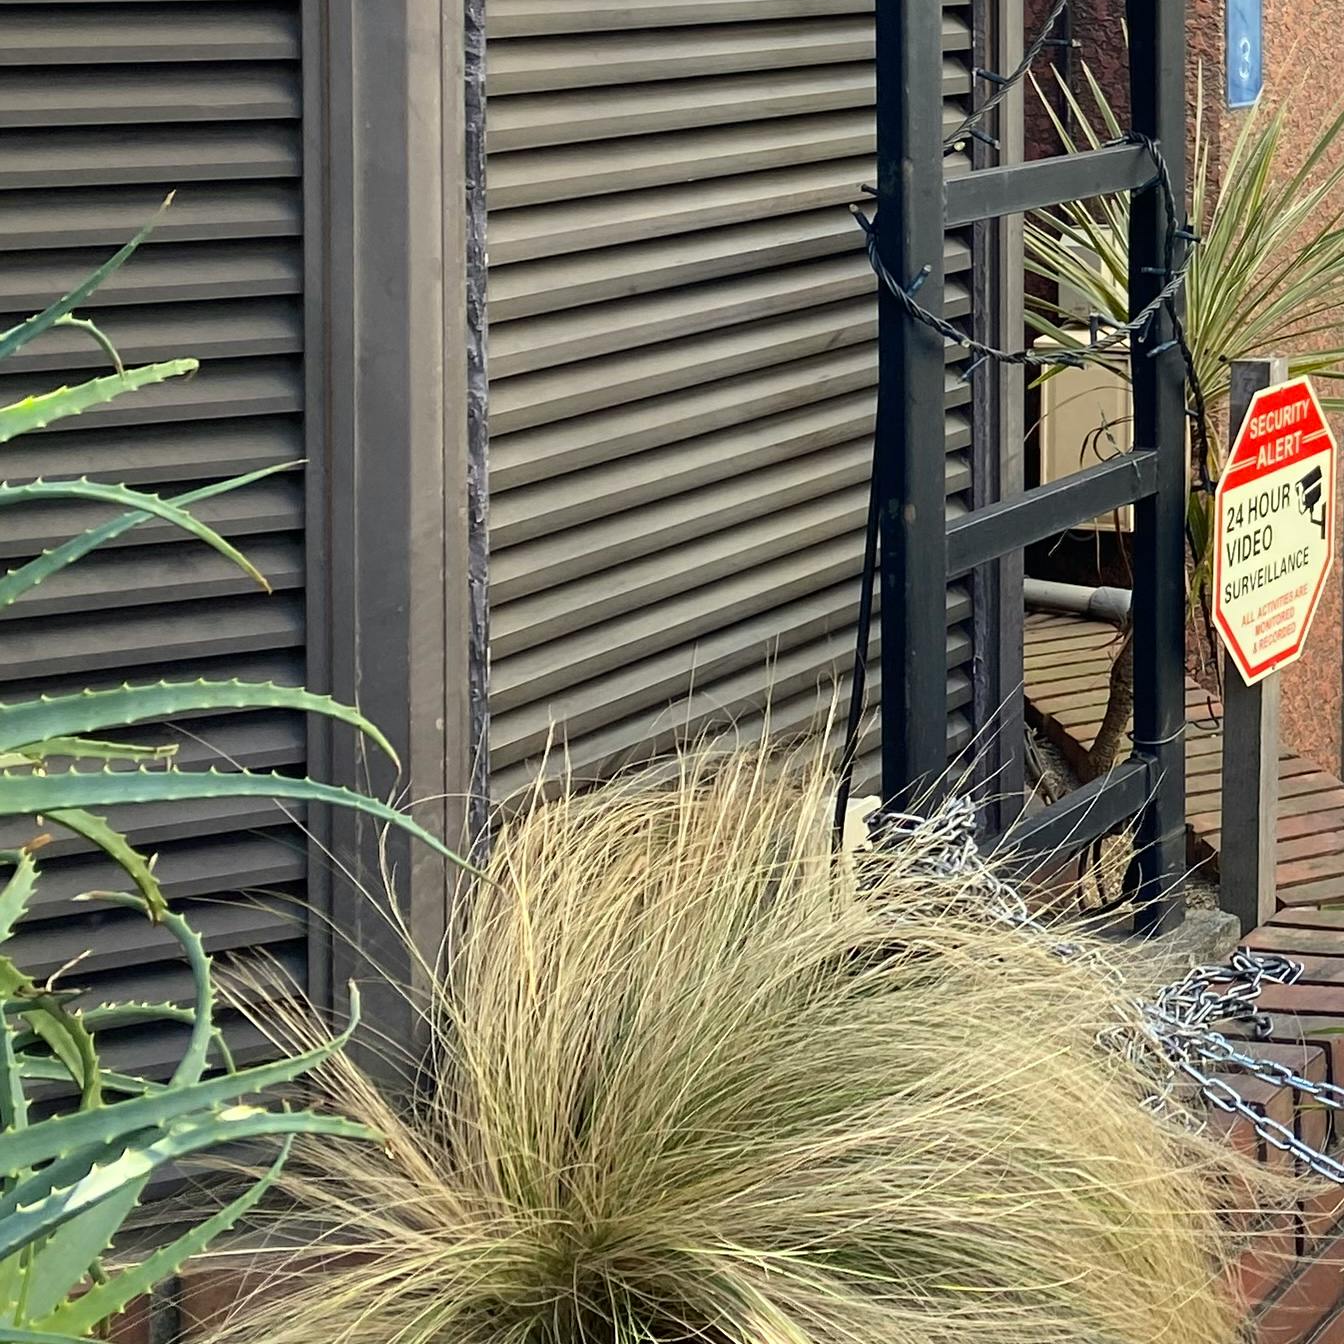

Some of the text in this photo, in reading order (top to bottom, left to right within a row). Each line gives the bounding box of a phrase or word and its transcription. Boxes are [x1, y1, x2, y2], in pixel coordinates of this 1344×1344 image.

[1249, 398, 1311, 440] SECURITY
[1256, 430, 1303, 470] ALERT
[1226, 483, 1291, 534] 24 HOUR
[1226, 524, 1273, 568] VIDEO
[1224, 545, 1310, 605] SURVEILLANCE
[1241, 583, 1308, 628] ALL ACTIVITIES ARE
[1255, 606, 1295, 636] MONITORED
[1259, 621, 1297, 650] RECORDED
